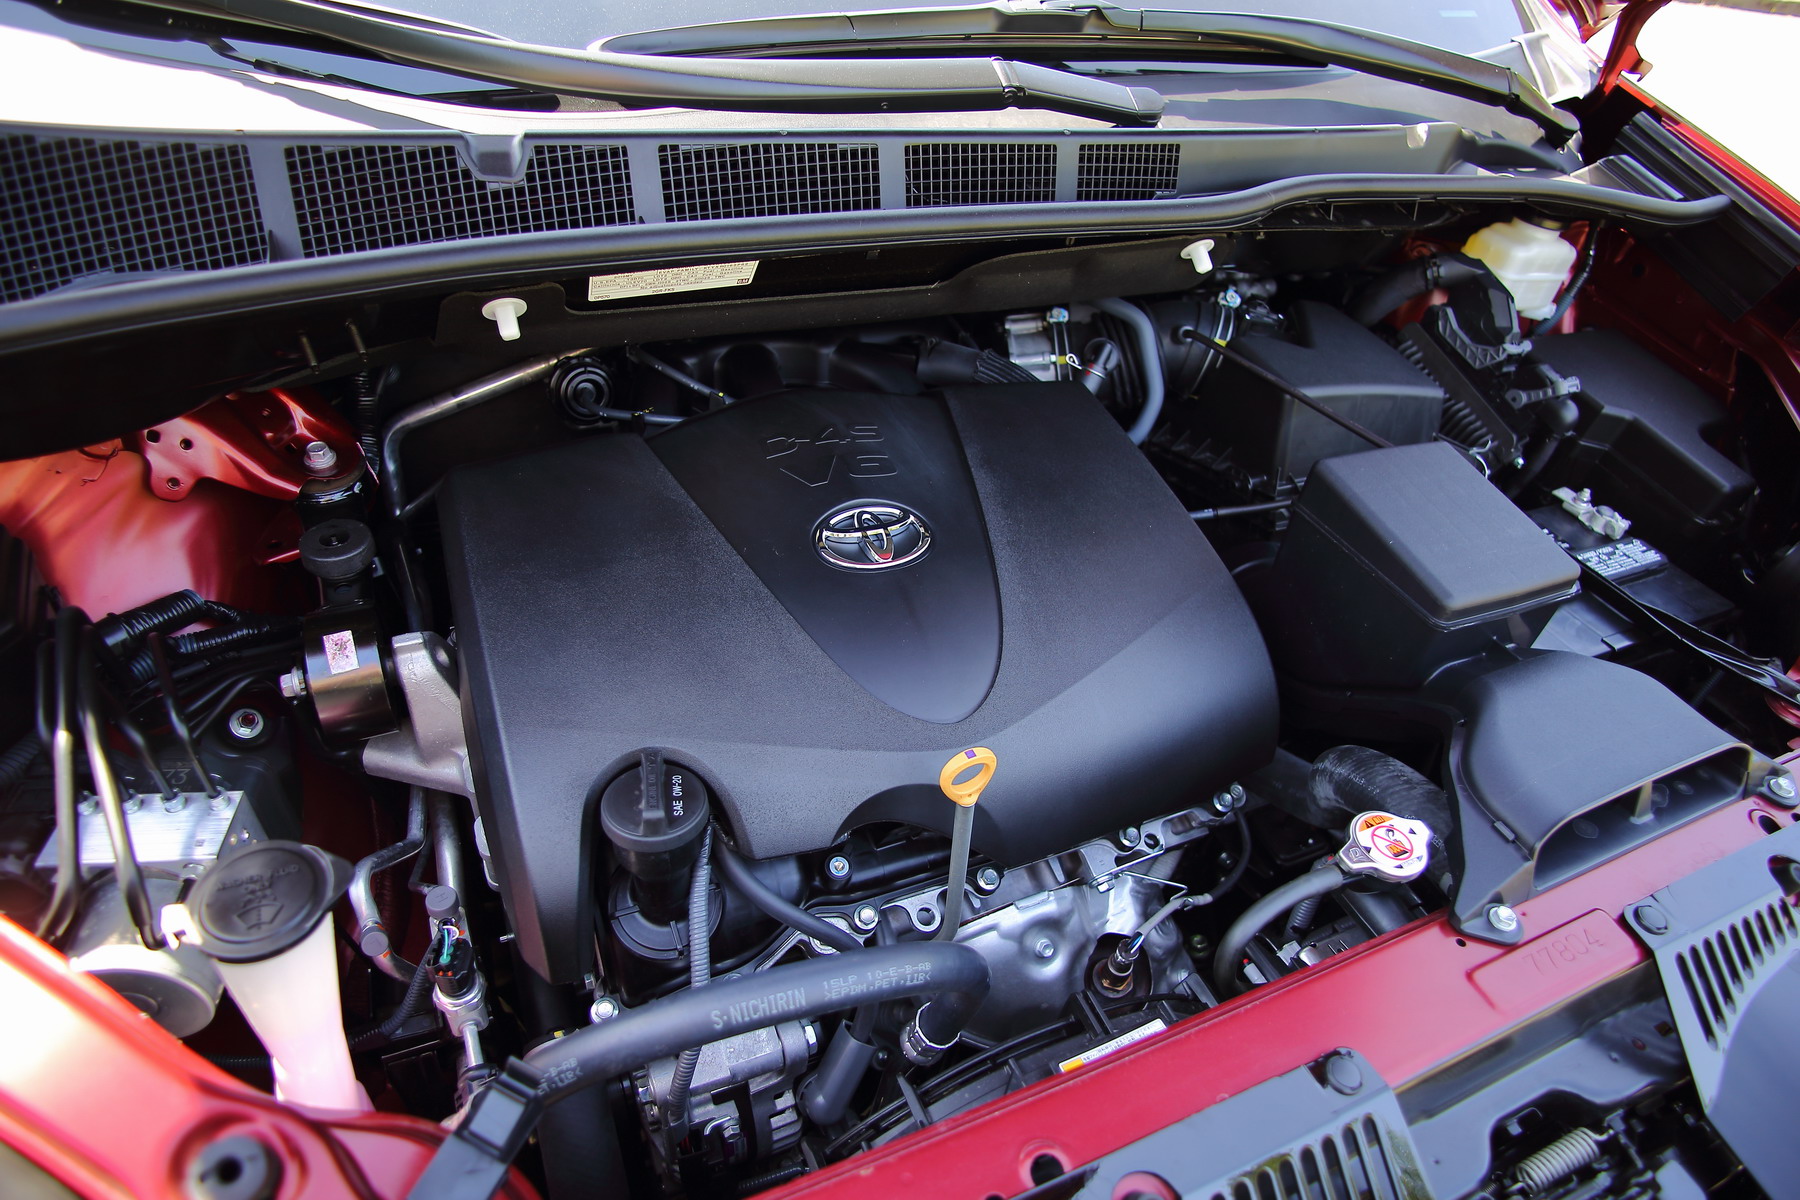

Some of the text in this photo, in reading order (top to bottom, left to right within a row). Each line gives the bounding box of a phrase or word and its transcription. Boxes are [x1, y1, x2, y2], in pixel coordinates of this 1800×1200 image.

[779, 455, 898, 487] V6
[671, 774, 684, 816] SAE 0W-20
[1521, 928, 1605, 976] 77804
